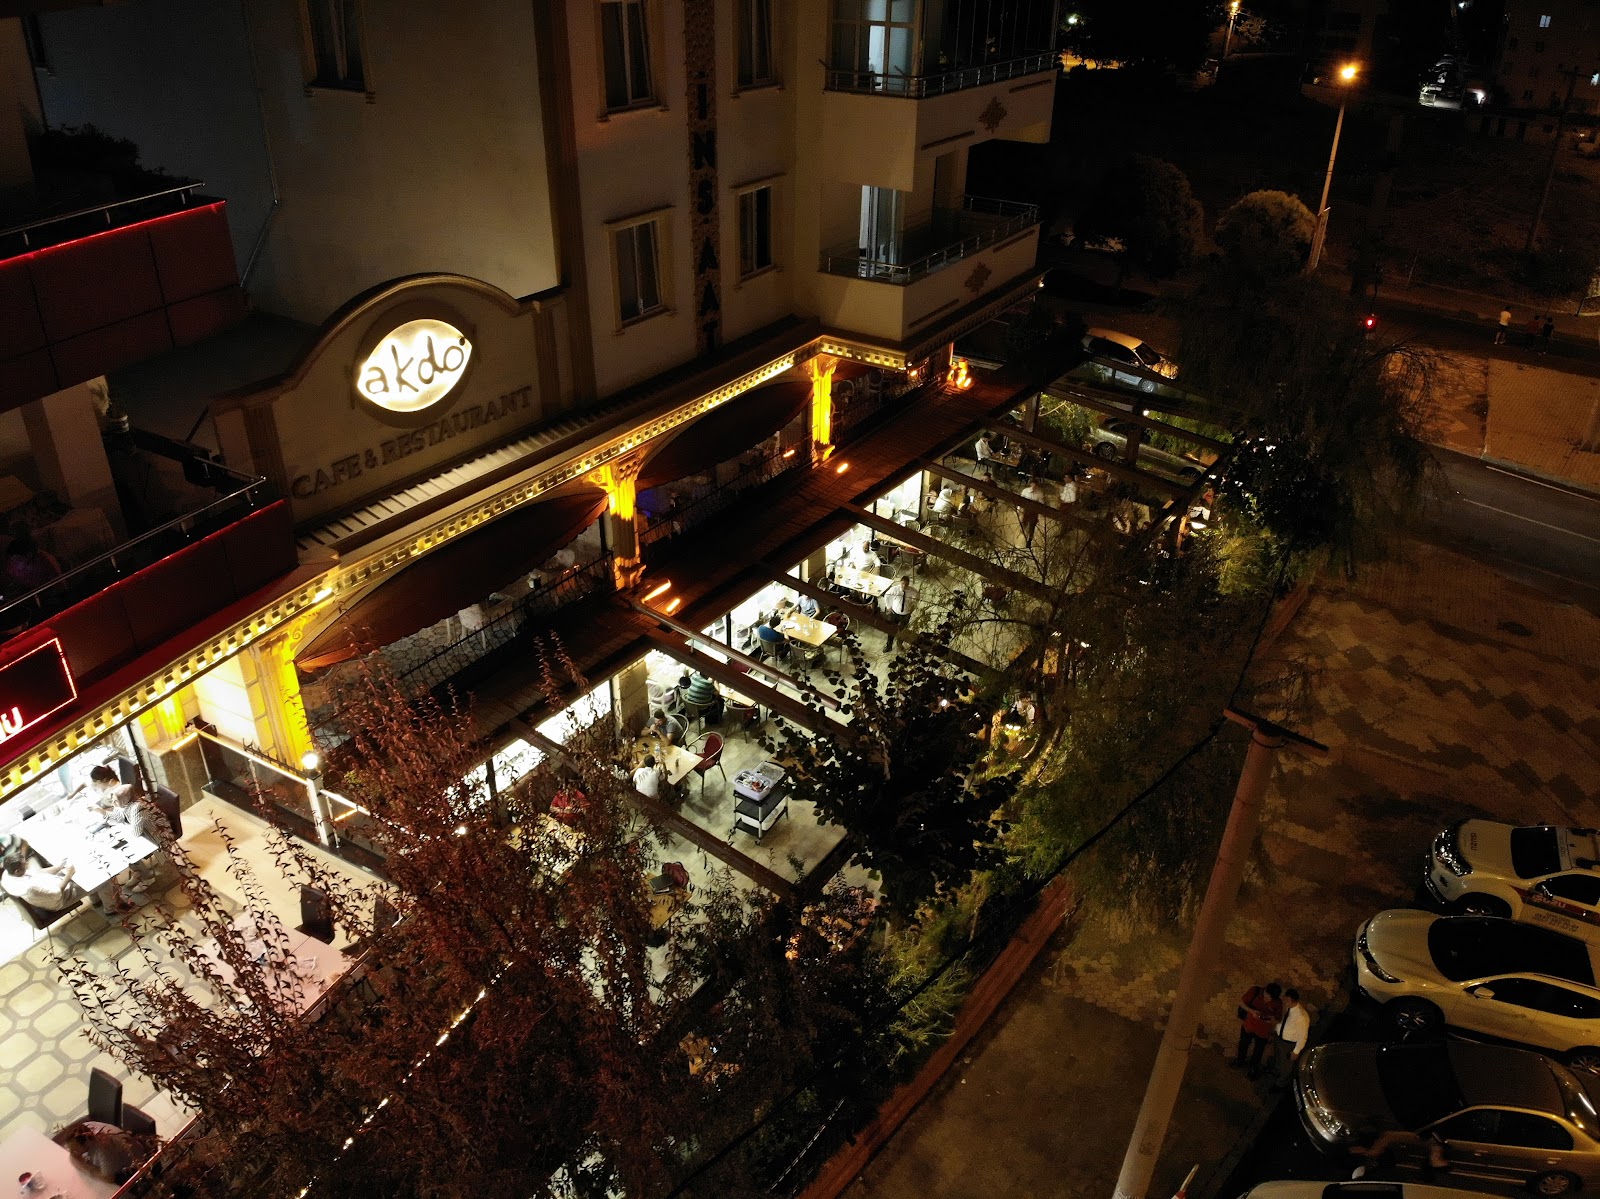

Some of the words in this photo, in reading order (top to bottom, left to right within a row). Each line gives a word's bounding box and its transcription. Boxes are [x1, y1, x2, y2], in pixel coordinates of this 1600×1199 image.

[365, 335, 465, 393] akdo
[292, 454, 362, 499] CAFE
[364, 450, 378, 469] &
[380, 385, 533, 465] RESTAURANT
